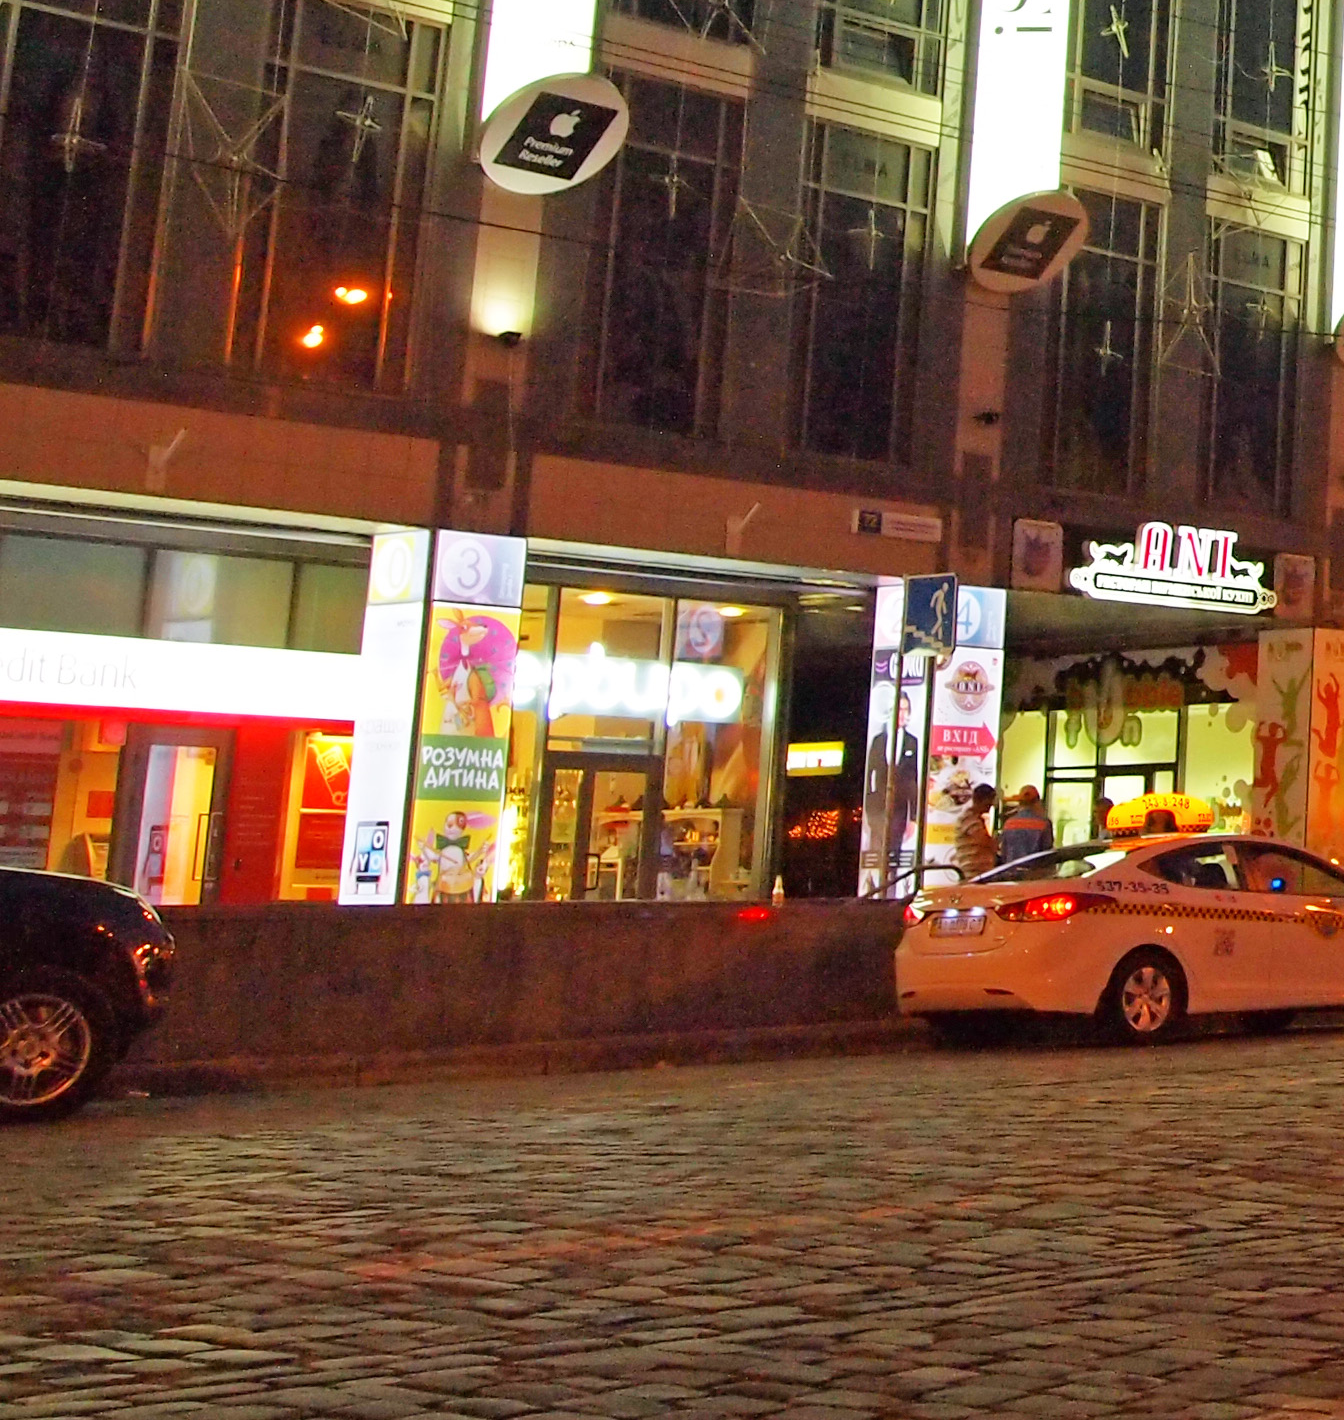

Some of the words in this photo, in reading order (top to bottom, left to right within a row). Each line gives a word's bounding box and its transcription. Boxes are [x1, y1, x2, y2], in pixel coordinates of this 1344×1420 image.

[517, 148, 564, 168] Reseller
[523, 136, 574, 156] Premium
[1136, 522, 1239, 582] ANI
[457, 547, 482, 590] 3
[957, 598, 973, 635] 4
[57, 653, 136, 689] Bank
[943, 728, 979, 746] ВХІД
[422, 745, 504, 769] РОЗУМНА
[423, 766, 499, 790] ДИТИНА
